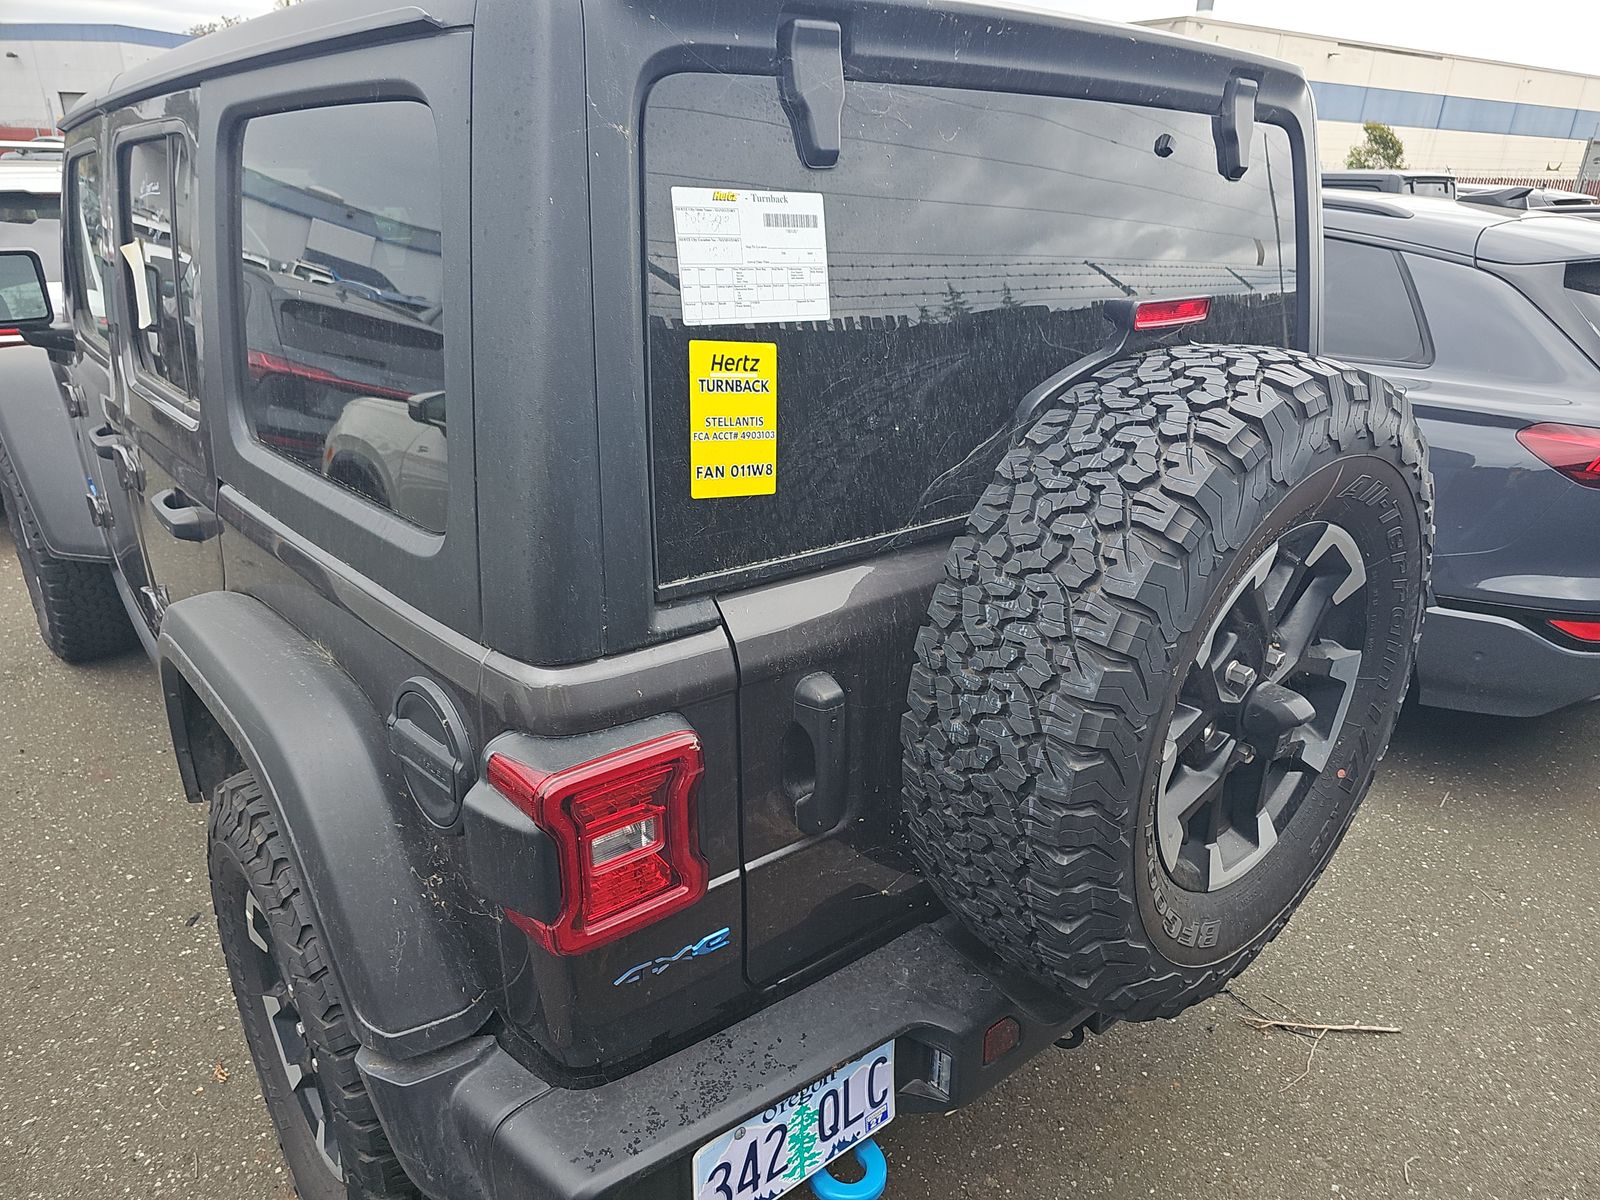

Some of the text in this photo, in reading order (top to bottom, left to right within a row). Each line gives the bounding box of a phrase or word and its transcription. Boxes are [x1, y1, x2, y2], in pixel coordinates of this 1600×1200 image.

[750, 193, 789, 204] Turnback
[710, 354, 761, 373] Hertz
[698, 379, 770, 393] TURNBACK
[705, 416, 764, 427] STELLANTIS
[693, 431, 775, 441] FCA ACCT# 4903103
[696, 463, 773, 479] FAN 011W8
[762, 1071, 837, 1124] Oregon
[707, 1056, 889, 1200] 342 QLC
